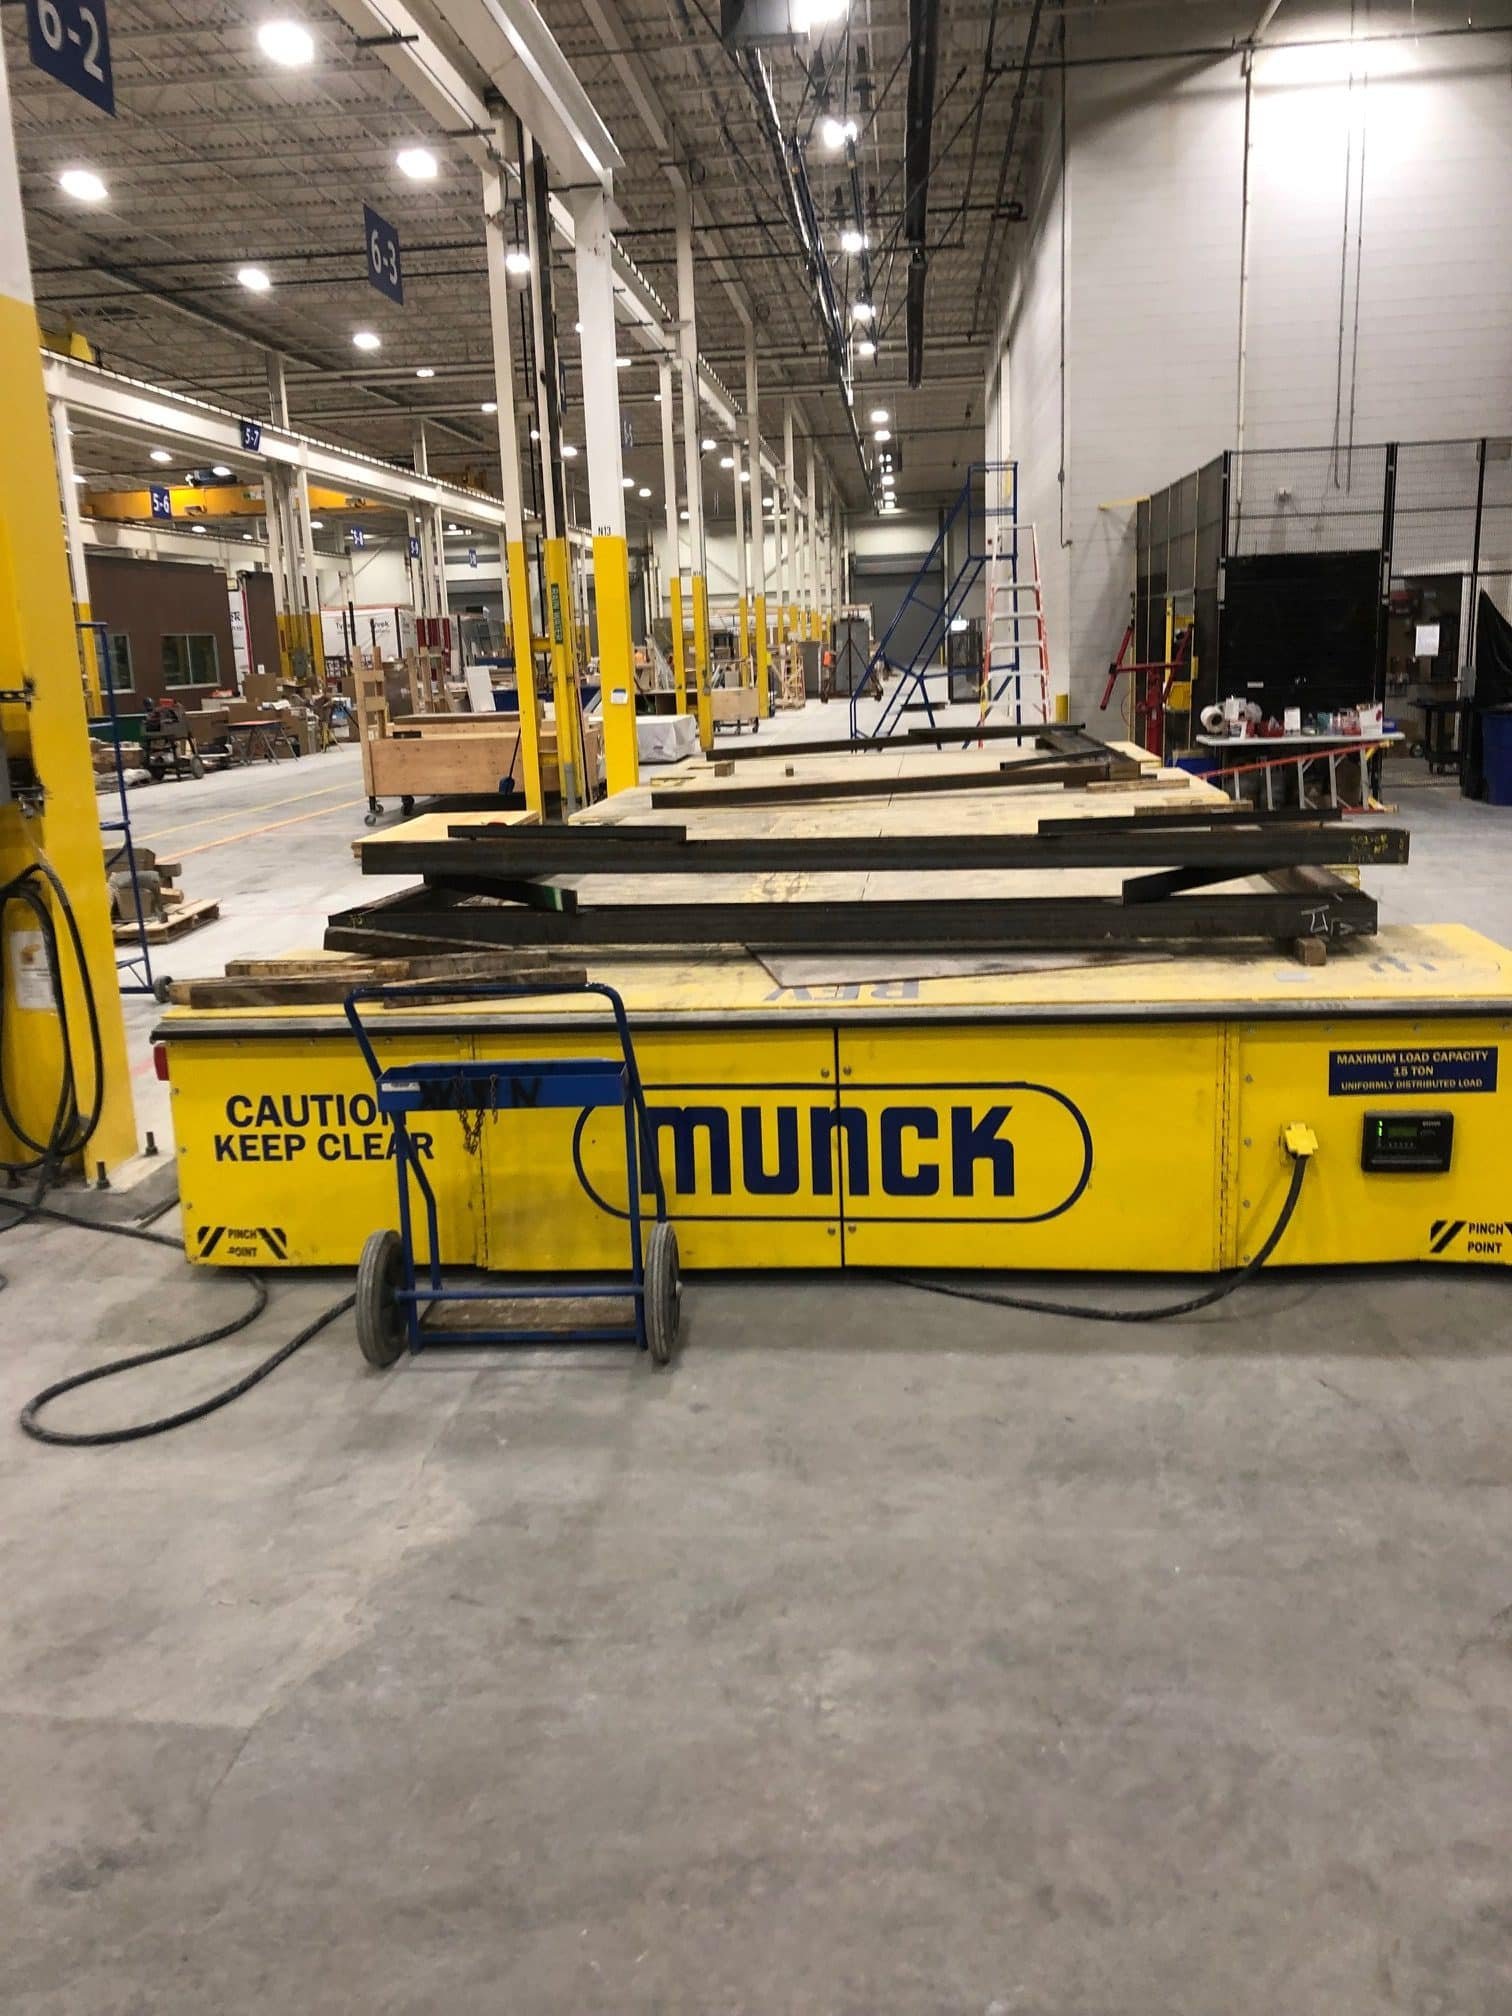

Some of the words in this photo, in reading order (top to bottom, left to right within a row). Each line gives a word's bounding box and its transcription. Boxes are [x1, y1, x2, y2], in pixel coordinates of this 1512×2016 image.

[38, 0, 104, 82] 6-2
[371, 229, 398, 285] 6-3
[245, 427, 259, 446] 5-7
[153, 493, 170, 514] 5-6
[598, 525, 612, 537] N13
[1336, 1053, 1397, 1065] MAXIMUM
[1400, 1051, 1430, 1064] LOAD
[1432, 1050, 1489, 1063] CAPACITY
[1410, 1065, 1434, 1077] TON
[1341, 1081, 1394, 1091] UNIFORMLY
[1396, 1079, 1456, 1090] DISTRIBUTED
[1458, 1077, 1483, 1089] LOAD
[214, 1133, 306, 1162] KEEP
[227, 1228, 258, 1240] PINCH
[1468, 1222, 1504, 1235] PINCH
[1467, 1241, 1502, 1254] POINT
